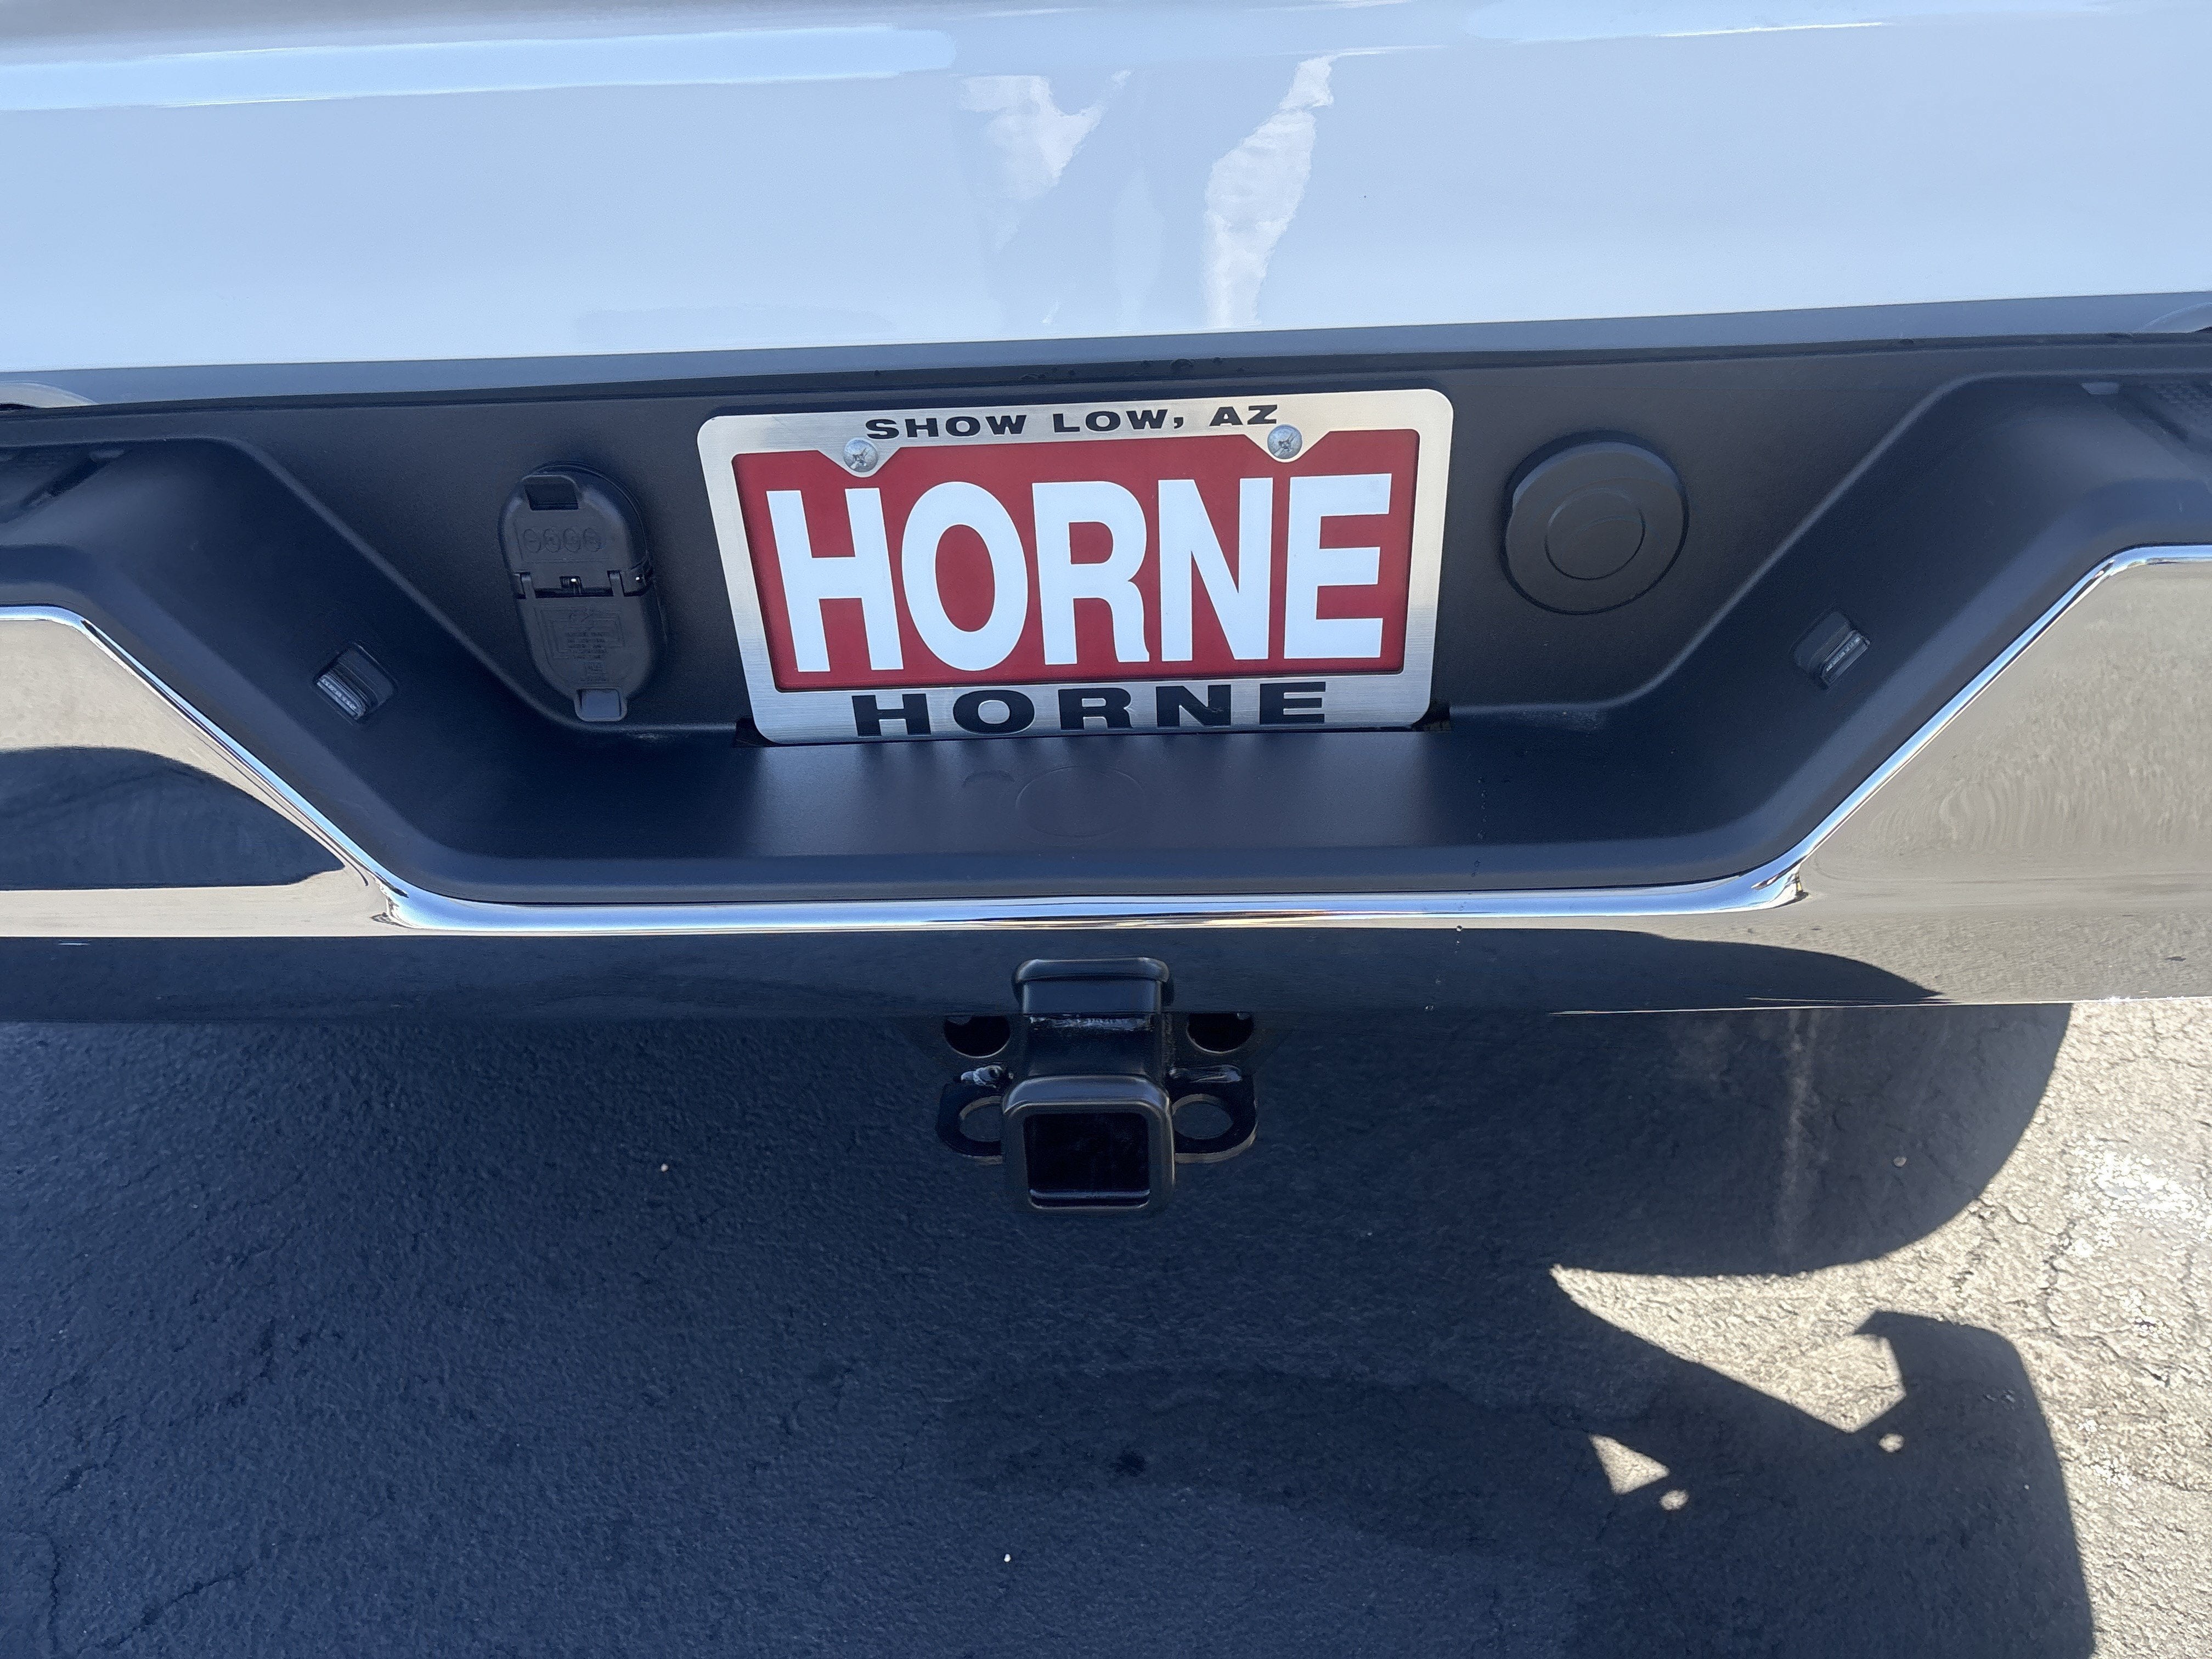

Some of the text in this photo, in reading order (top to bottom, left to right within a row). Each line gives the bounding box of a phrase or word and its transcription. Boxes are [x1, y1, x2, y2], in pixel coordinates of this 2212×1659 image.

[865, 404, 1278, 439] SHOW LOW, AZ
[766, 473, 1392, 673] HORNE
[851, 681, 1327, 737] HORNE
